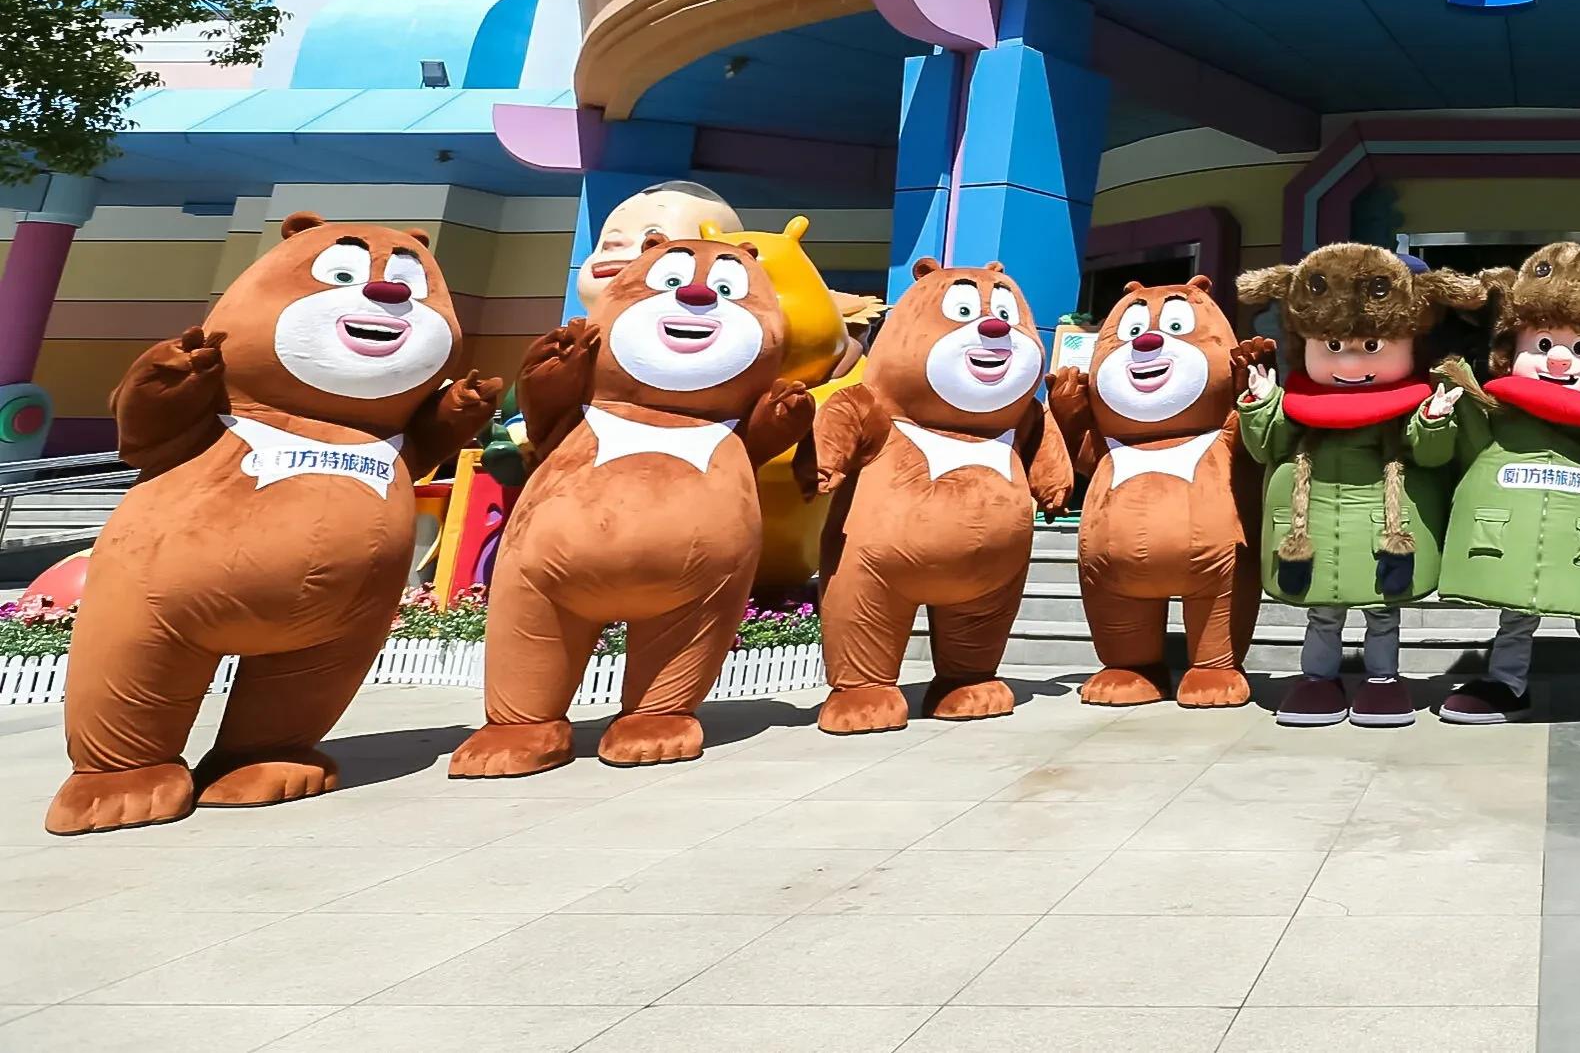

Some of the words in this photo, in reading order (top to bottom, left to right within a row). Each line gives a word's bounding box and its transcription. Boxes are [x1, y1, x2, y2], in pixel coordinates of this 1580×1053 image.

[252, 450, 390, 480] 门方特旅游区
